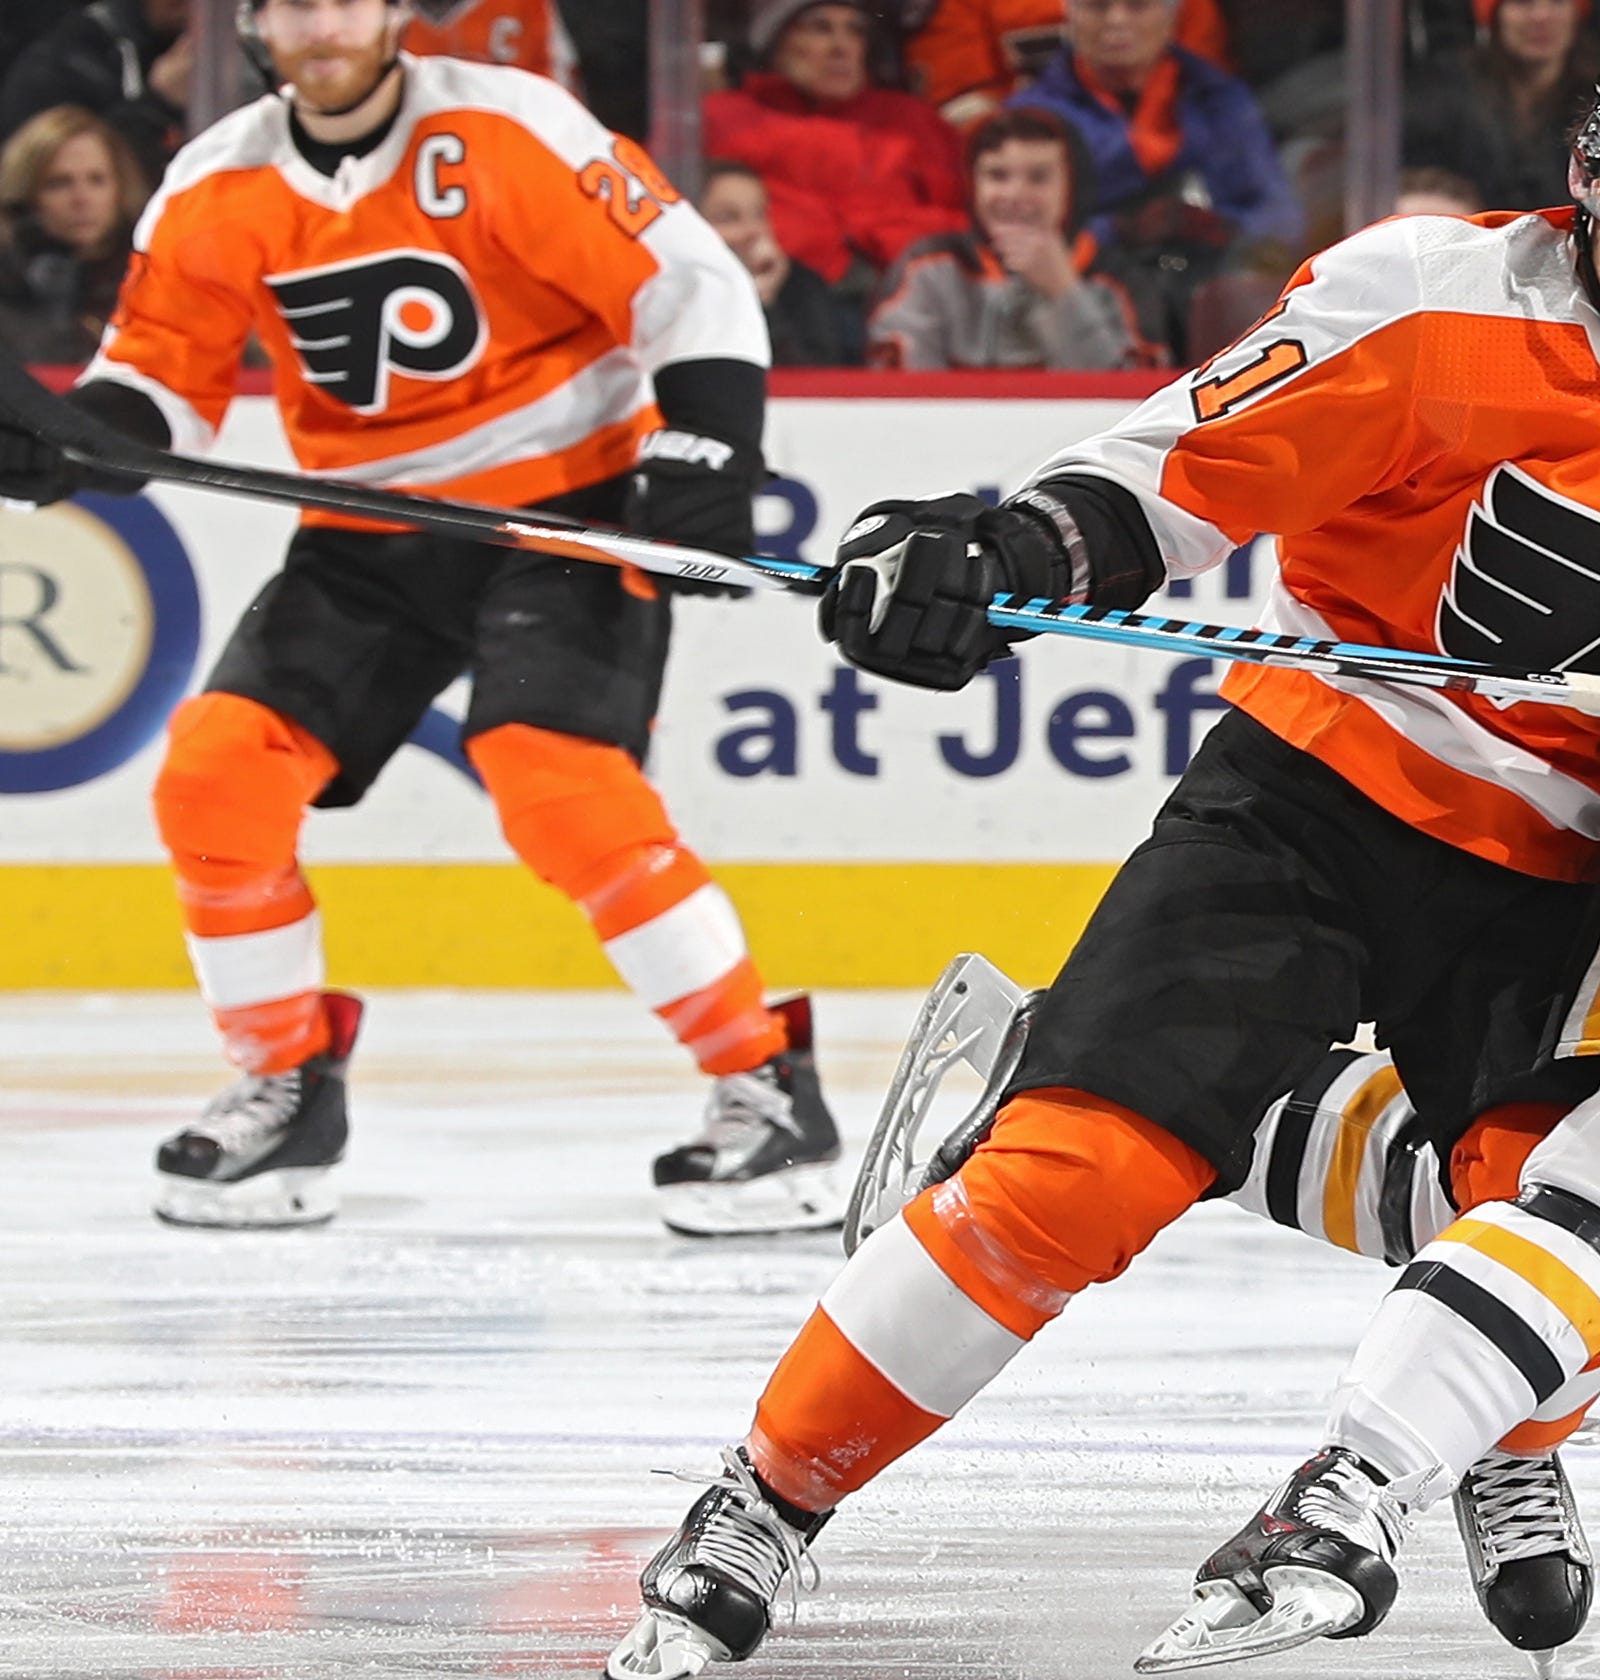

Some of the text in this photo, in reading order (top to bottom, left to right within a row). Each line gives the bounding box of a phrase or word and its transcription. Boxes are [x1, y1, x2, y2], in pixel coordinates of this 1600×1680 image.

[413, 131, 468, 220] C
[714, 655, 1232, 779] at Jef
